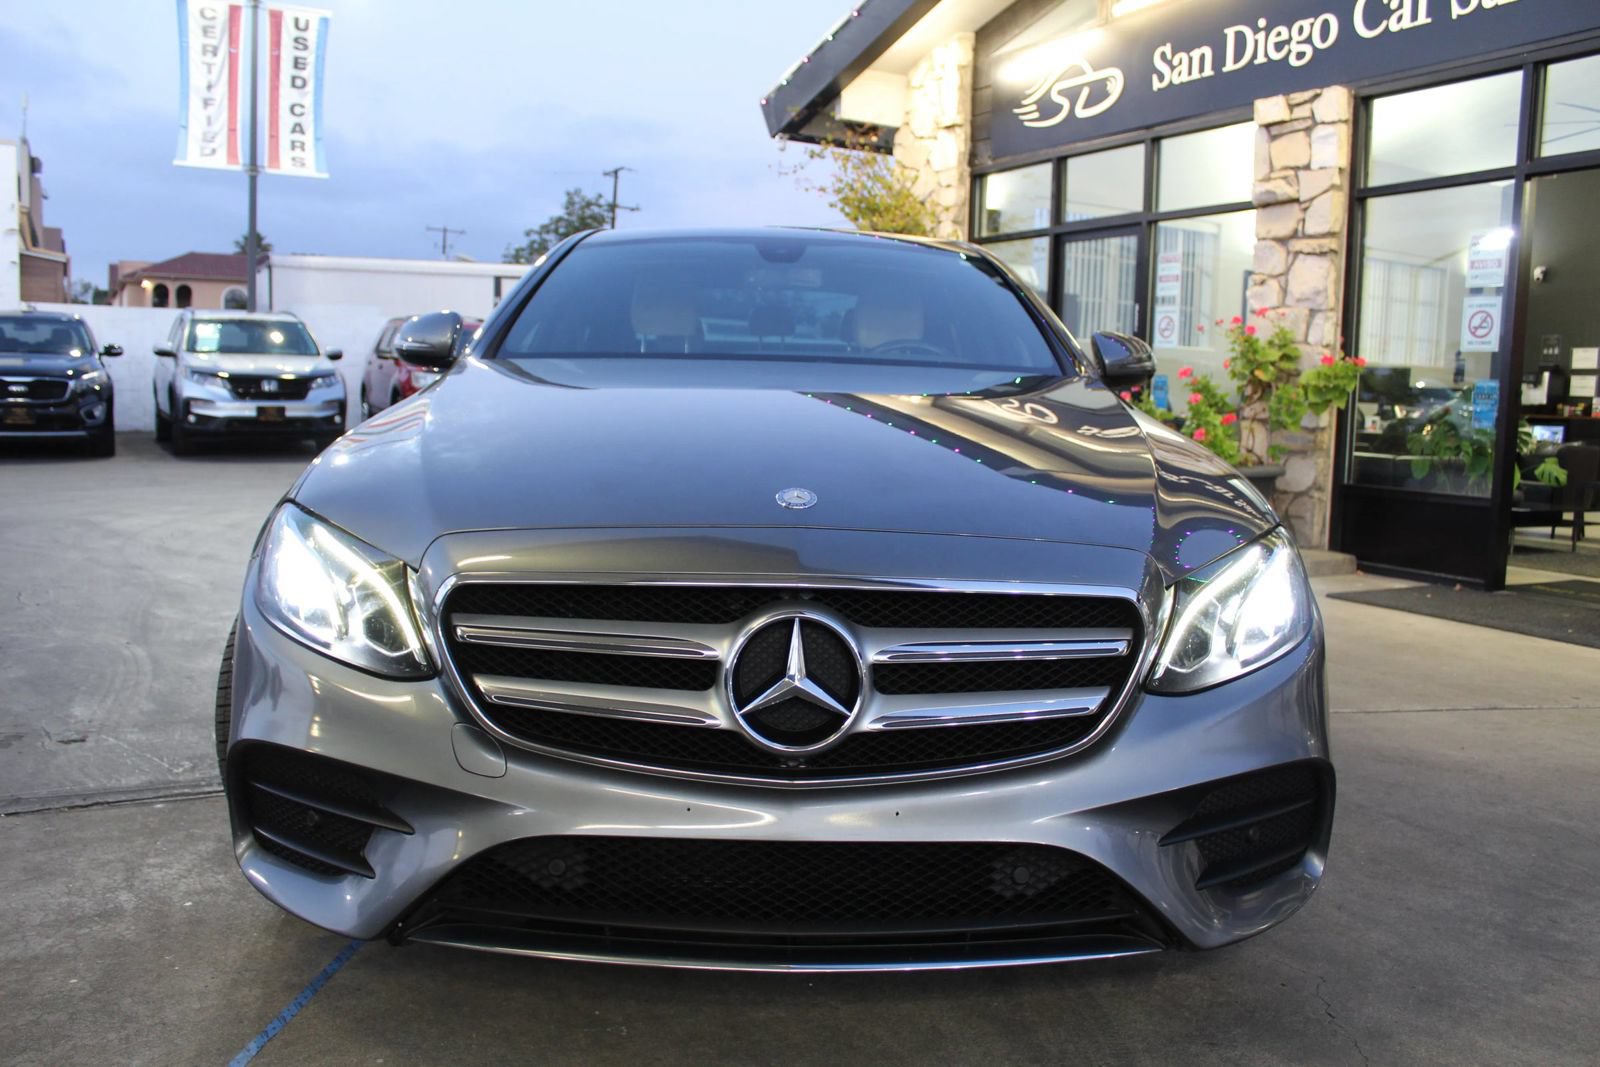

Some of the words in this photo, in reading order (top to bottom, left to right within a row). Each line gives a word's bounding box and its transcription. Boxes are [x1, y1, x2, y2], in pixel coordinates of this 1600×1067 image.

[290, 16, 310, 90] USED
[1151, 42, 1215, 91] San
[1221, 12, 1339, 72] Diego
[289, 103, 307, 168] CARS
